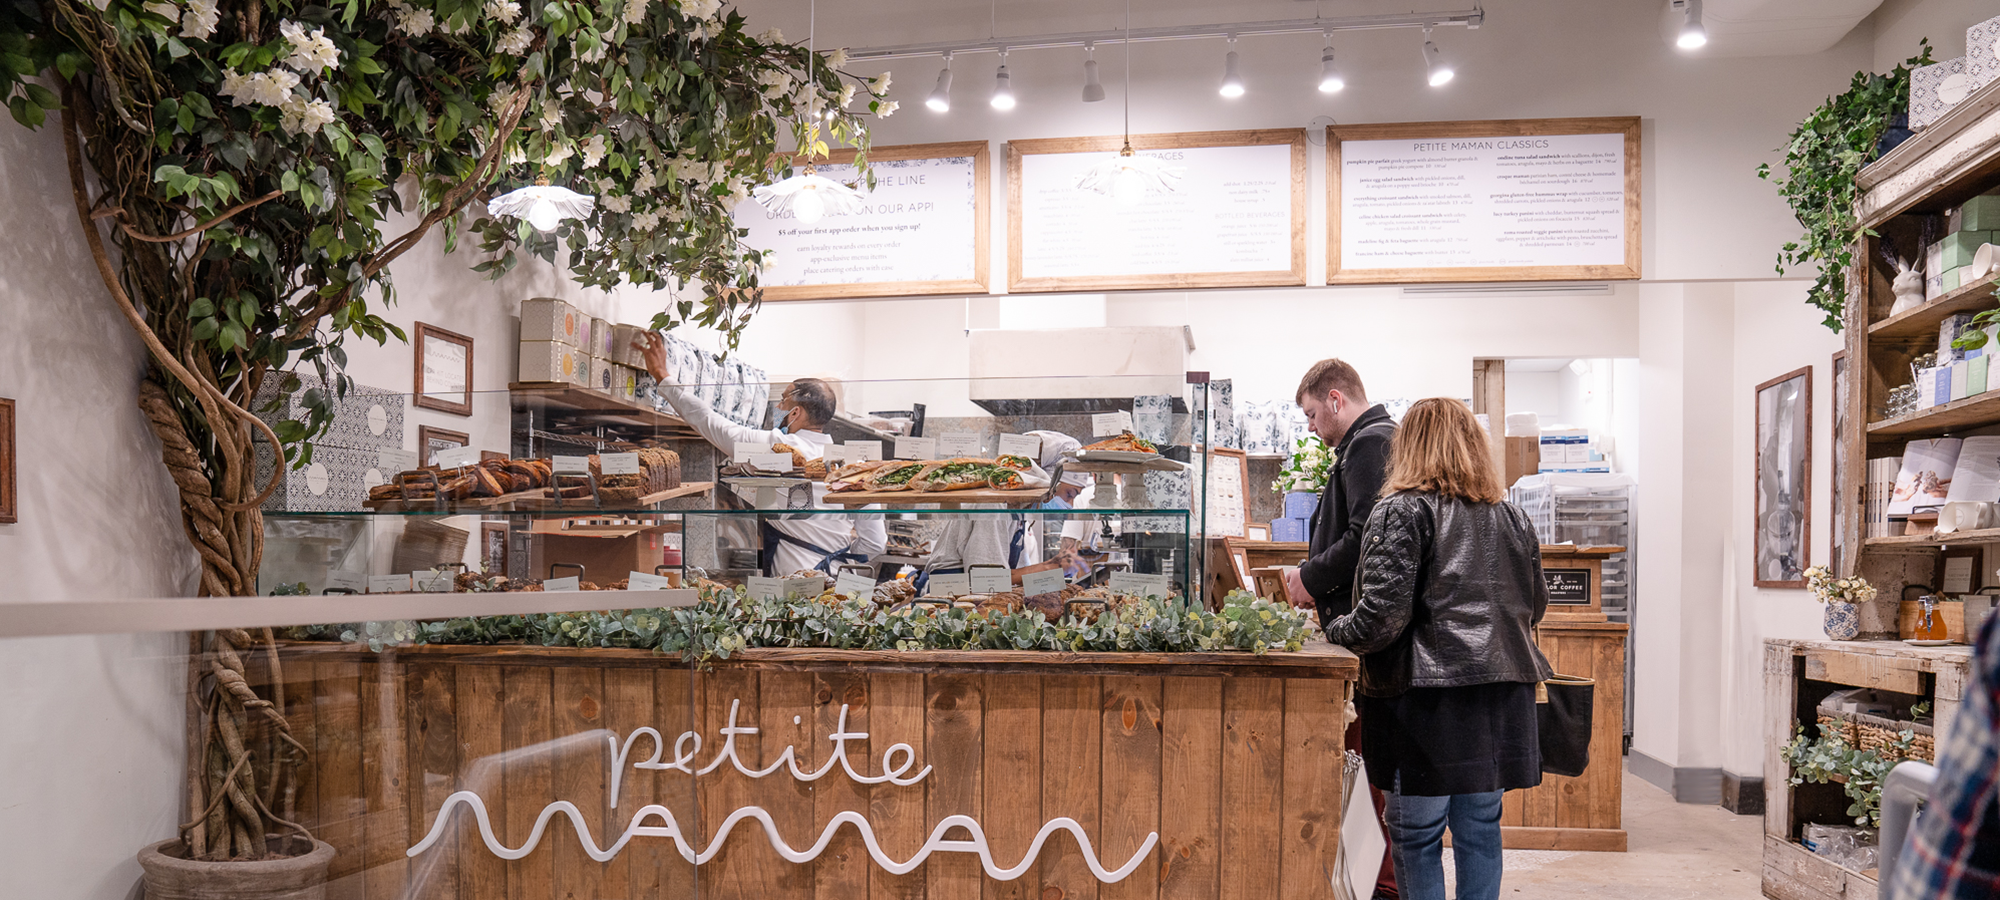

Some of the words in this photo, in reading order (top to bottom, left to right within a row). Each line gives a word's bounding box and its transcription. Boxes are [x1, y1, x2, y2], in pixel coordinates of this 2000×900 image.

[1414, 142, 1447, 152] PETITE
[1451, 141, 1493, 150] MAMAN
[1496, 140, 1550, 150] CLASSICS
[898, 174, 926, 186] LINE
[878, 204, 904, 214] OUR
[908, 202, 934, 212] APP!
[810, 255, 850, 264] app-exclusive
[820, 266, 844, 274] catering
[609, 697, 933, 808] petite
